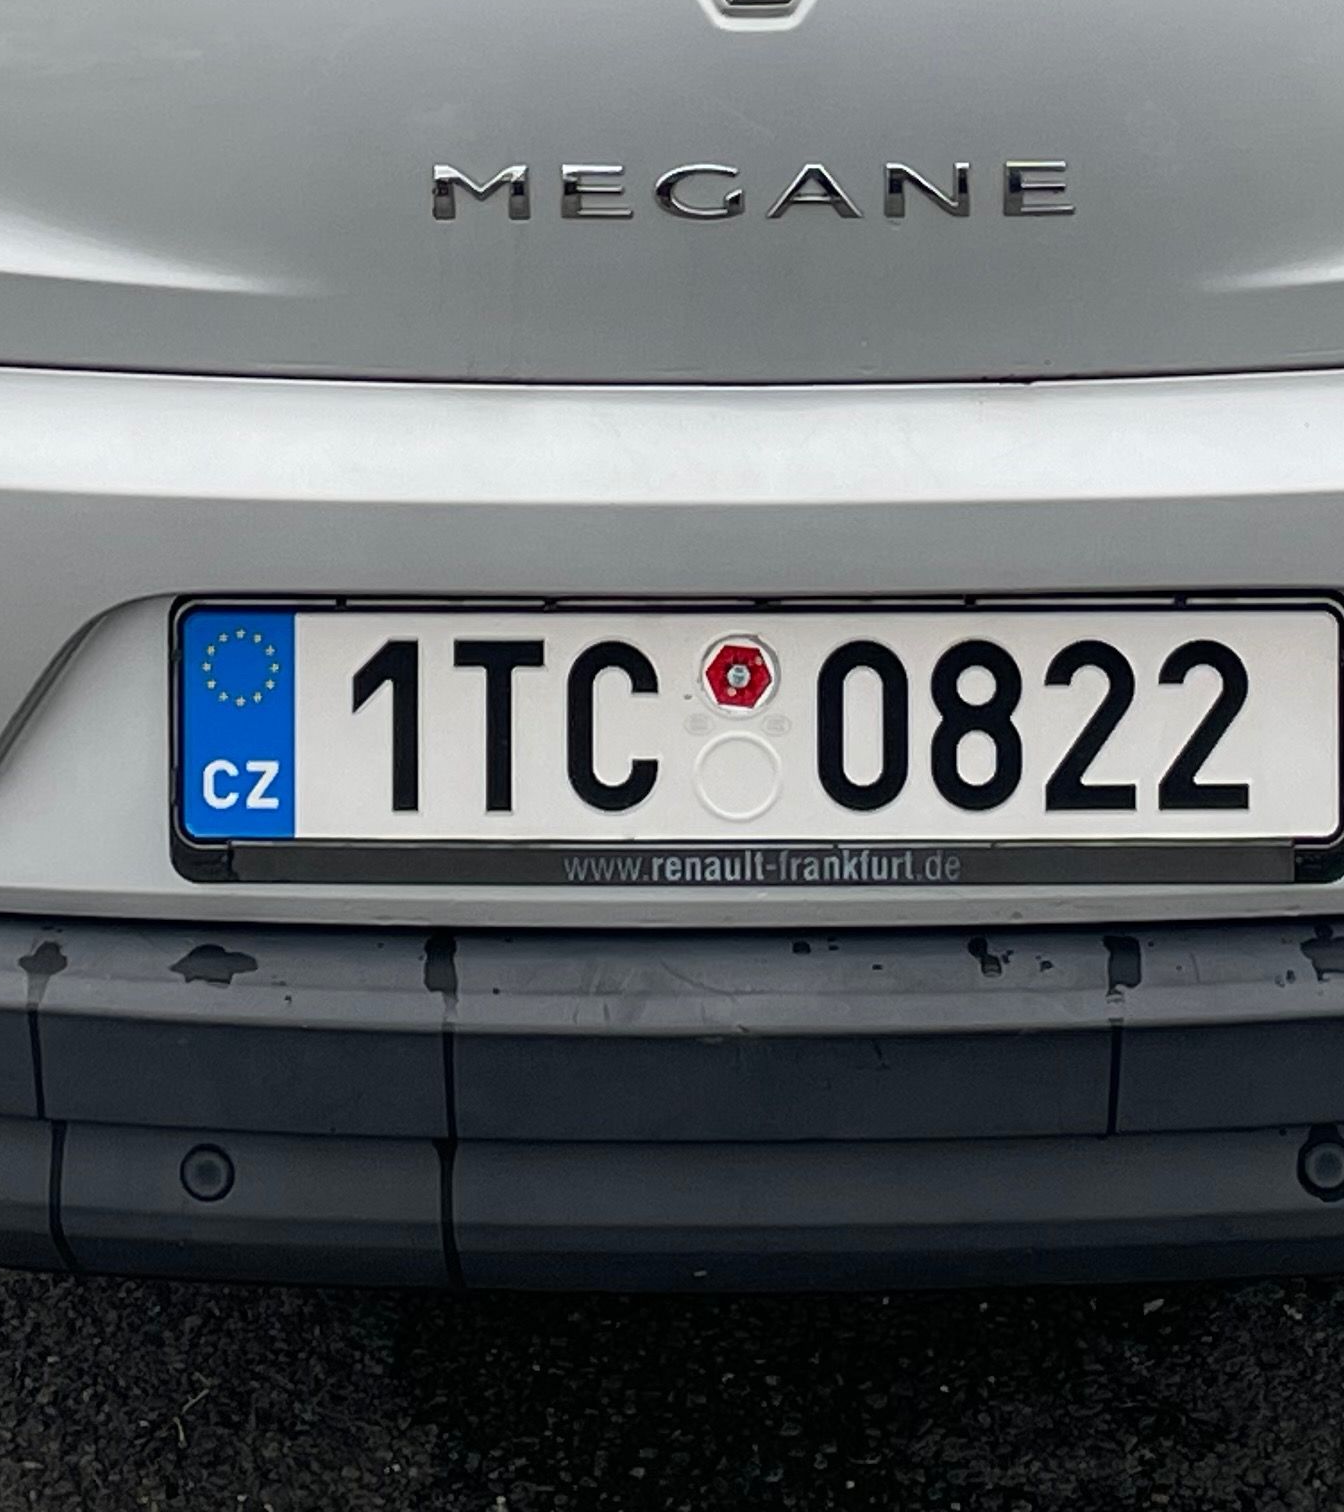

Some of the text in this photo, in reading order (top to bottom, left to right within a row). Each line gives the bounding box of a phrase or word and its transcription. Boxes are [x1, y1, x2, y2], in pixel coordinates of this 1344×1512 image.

[431, 161, 1077, 220] MEGANE
[352, 638, 1250, 813] 1TC 0822
[201, 759, 281, 810] CZ
[562, 849, 962, 882] www.renault-frankfurt.de
